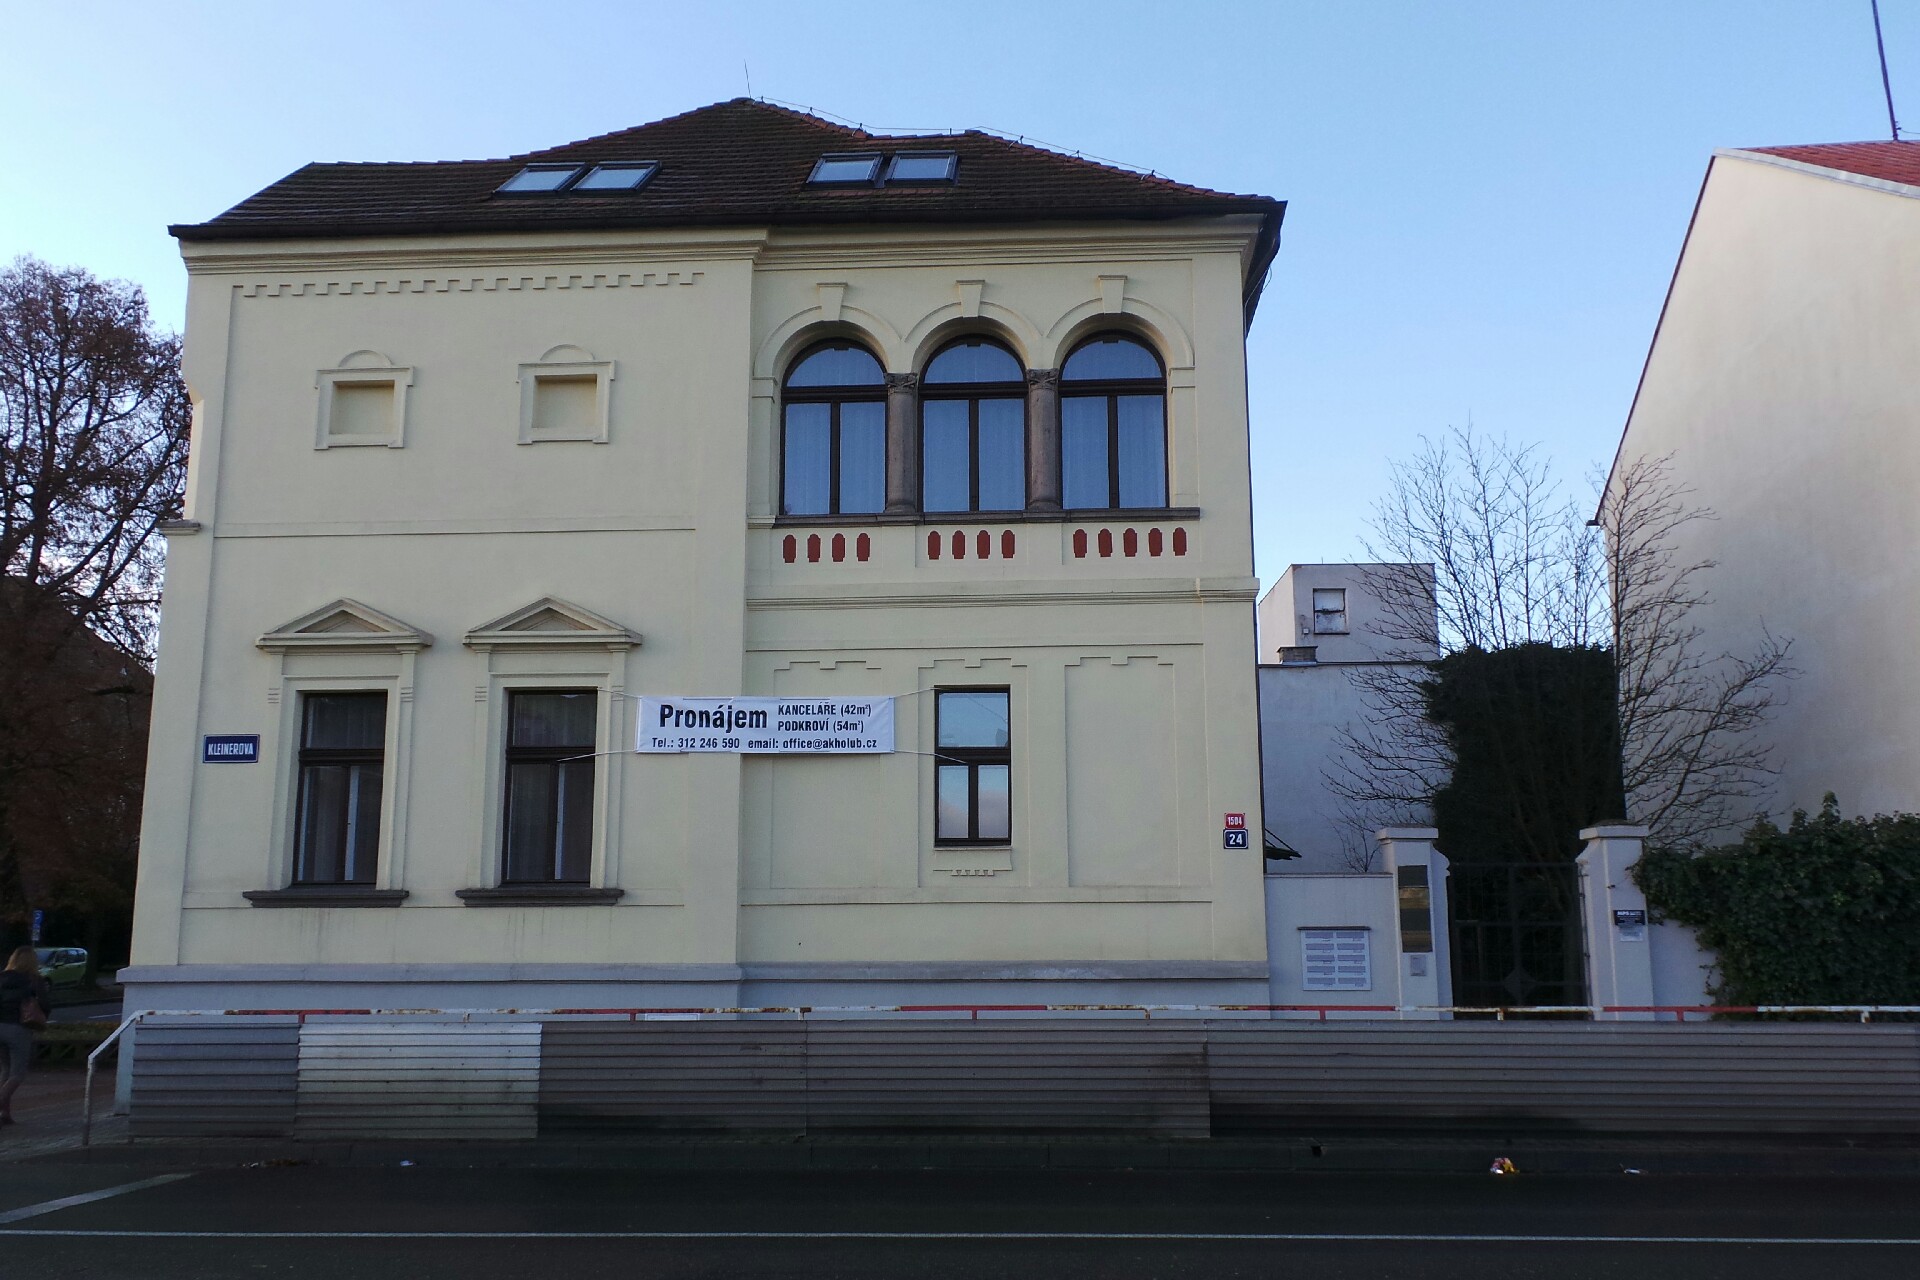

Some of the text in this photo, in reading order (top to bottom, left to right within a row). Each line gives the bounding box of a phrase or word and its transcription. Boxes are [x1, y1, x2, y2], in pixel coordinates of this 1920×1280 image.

[778, 702, 836, 716] KANCELÁŘE
[659, 704, 768, 733] Pronájem
[778, 718, 829, 732] PODKROVÍ
[208, 743, 254, 755] KLEINEROVA
[652, 738, 877, 750] Tel.: 312 246 590 email: office@akholub.cz
[1228, 817, 1242, 825] 1504
[1229, 834, 1243, 844] 24
